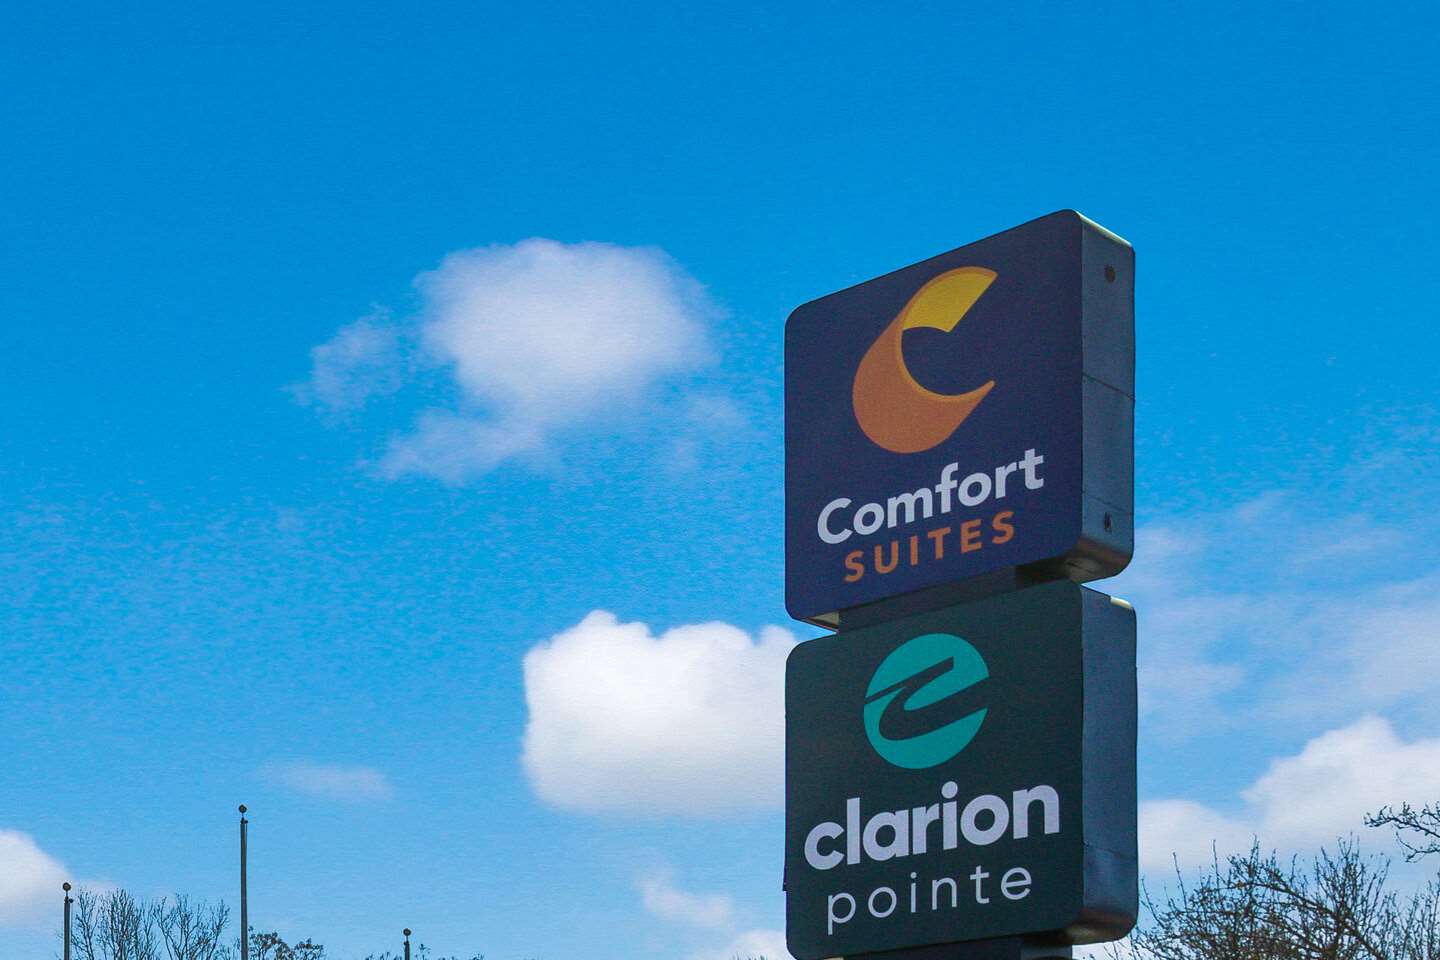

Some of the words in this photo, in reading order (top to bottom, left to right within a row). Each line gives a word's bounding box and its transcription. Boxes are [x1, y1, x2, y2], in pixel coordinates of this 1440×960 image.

[816, 447, 1045, 545] Comfort
[843, 510, 1016, 583] SUITES
[803, 780, 1060, 871] clarion
[826, 864, 1033, 936] pointe
